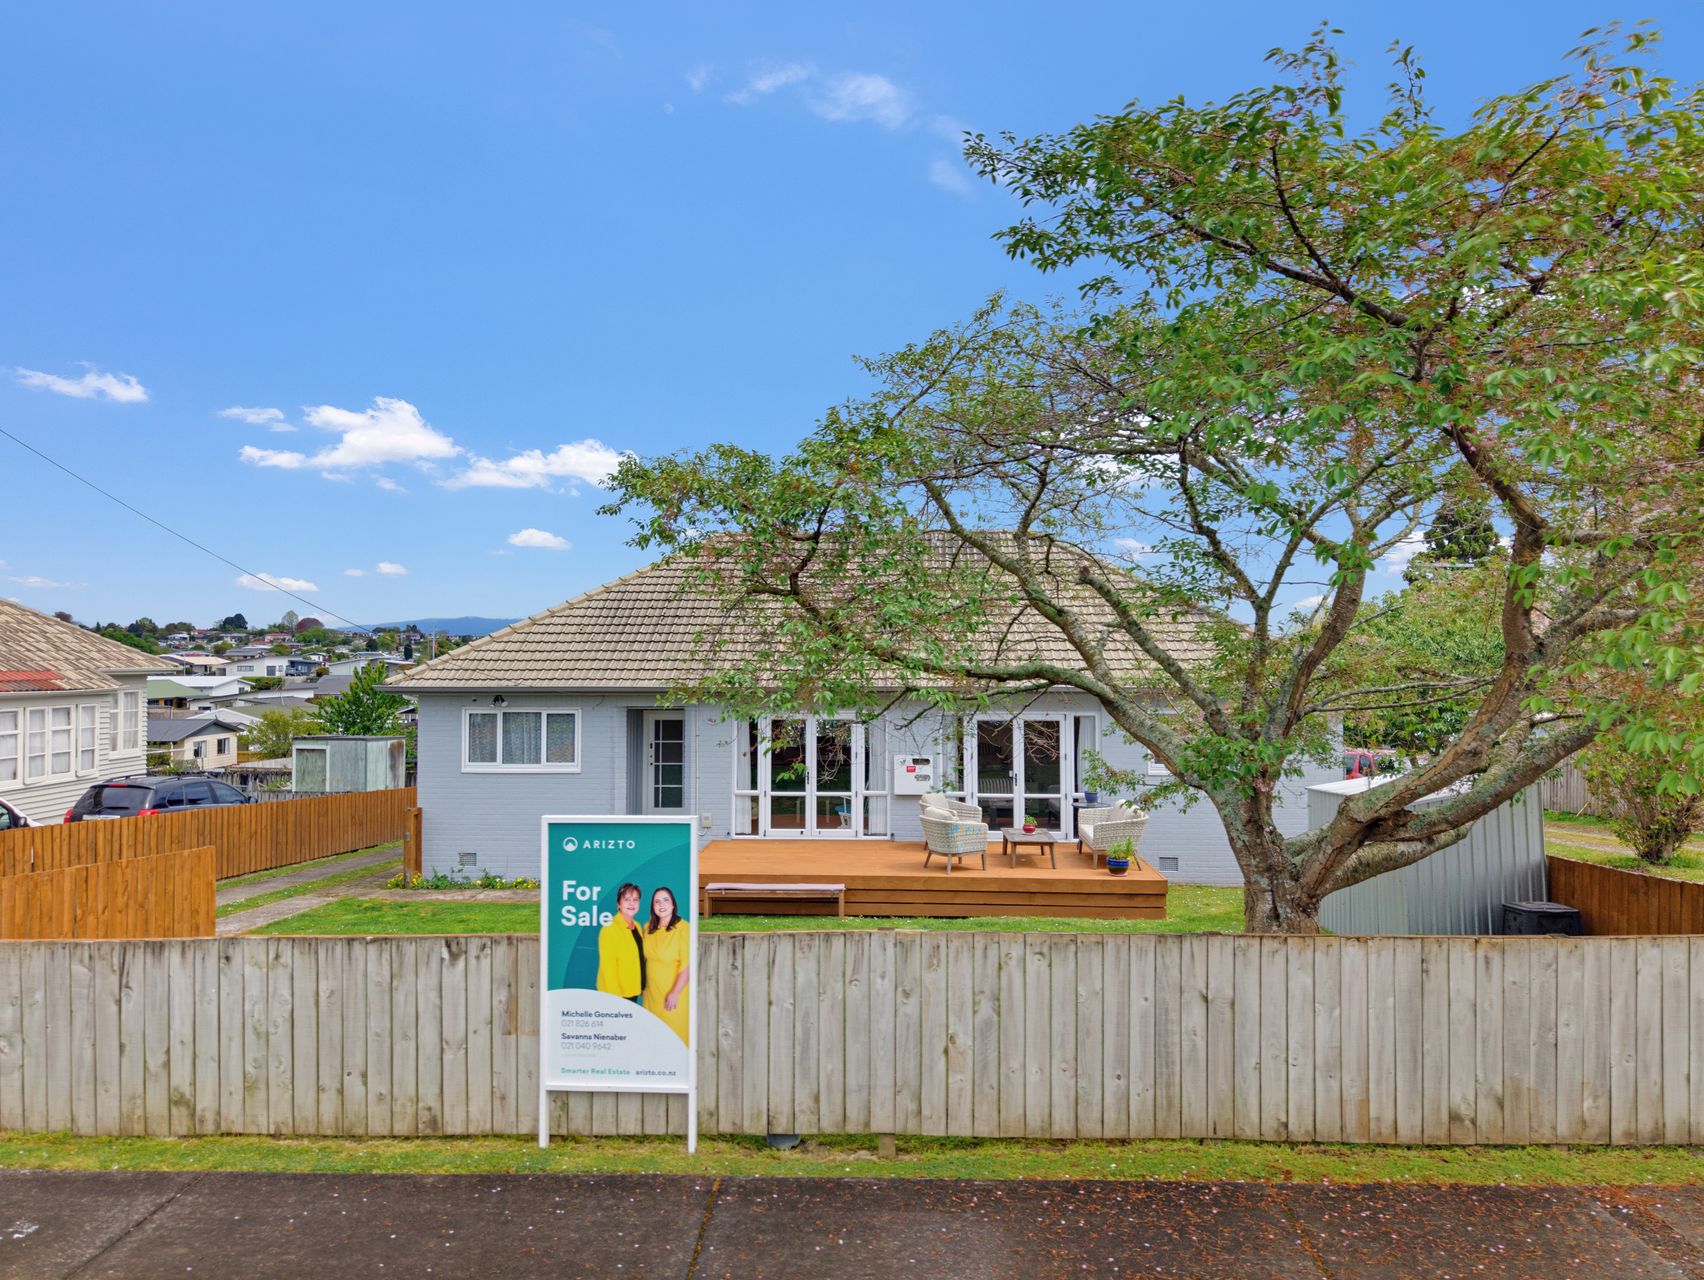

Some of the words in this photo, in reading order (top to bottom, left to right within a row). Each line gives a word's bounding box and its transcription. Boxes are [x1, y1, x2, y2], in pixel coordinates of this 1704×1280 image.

[583, 840, 635, 849] ARIZTO
[562, 880, 601, 901] For
[561, 905, 613, 927] Sale
[561, 1010, 593, 1019] Michelle
[594, 1011, 632, 1019] Goncalves
[561, 1019, 574, 1028] 021
[561, 1032, 592, 1041] Savanna
[593, 1033, 627, 1041] Nienaber
[561, 1042, 574, 1050] 021
[576, 1042, 590, 1050] 040
[561, 1067, 589, 1075] Smarter
